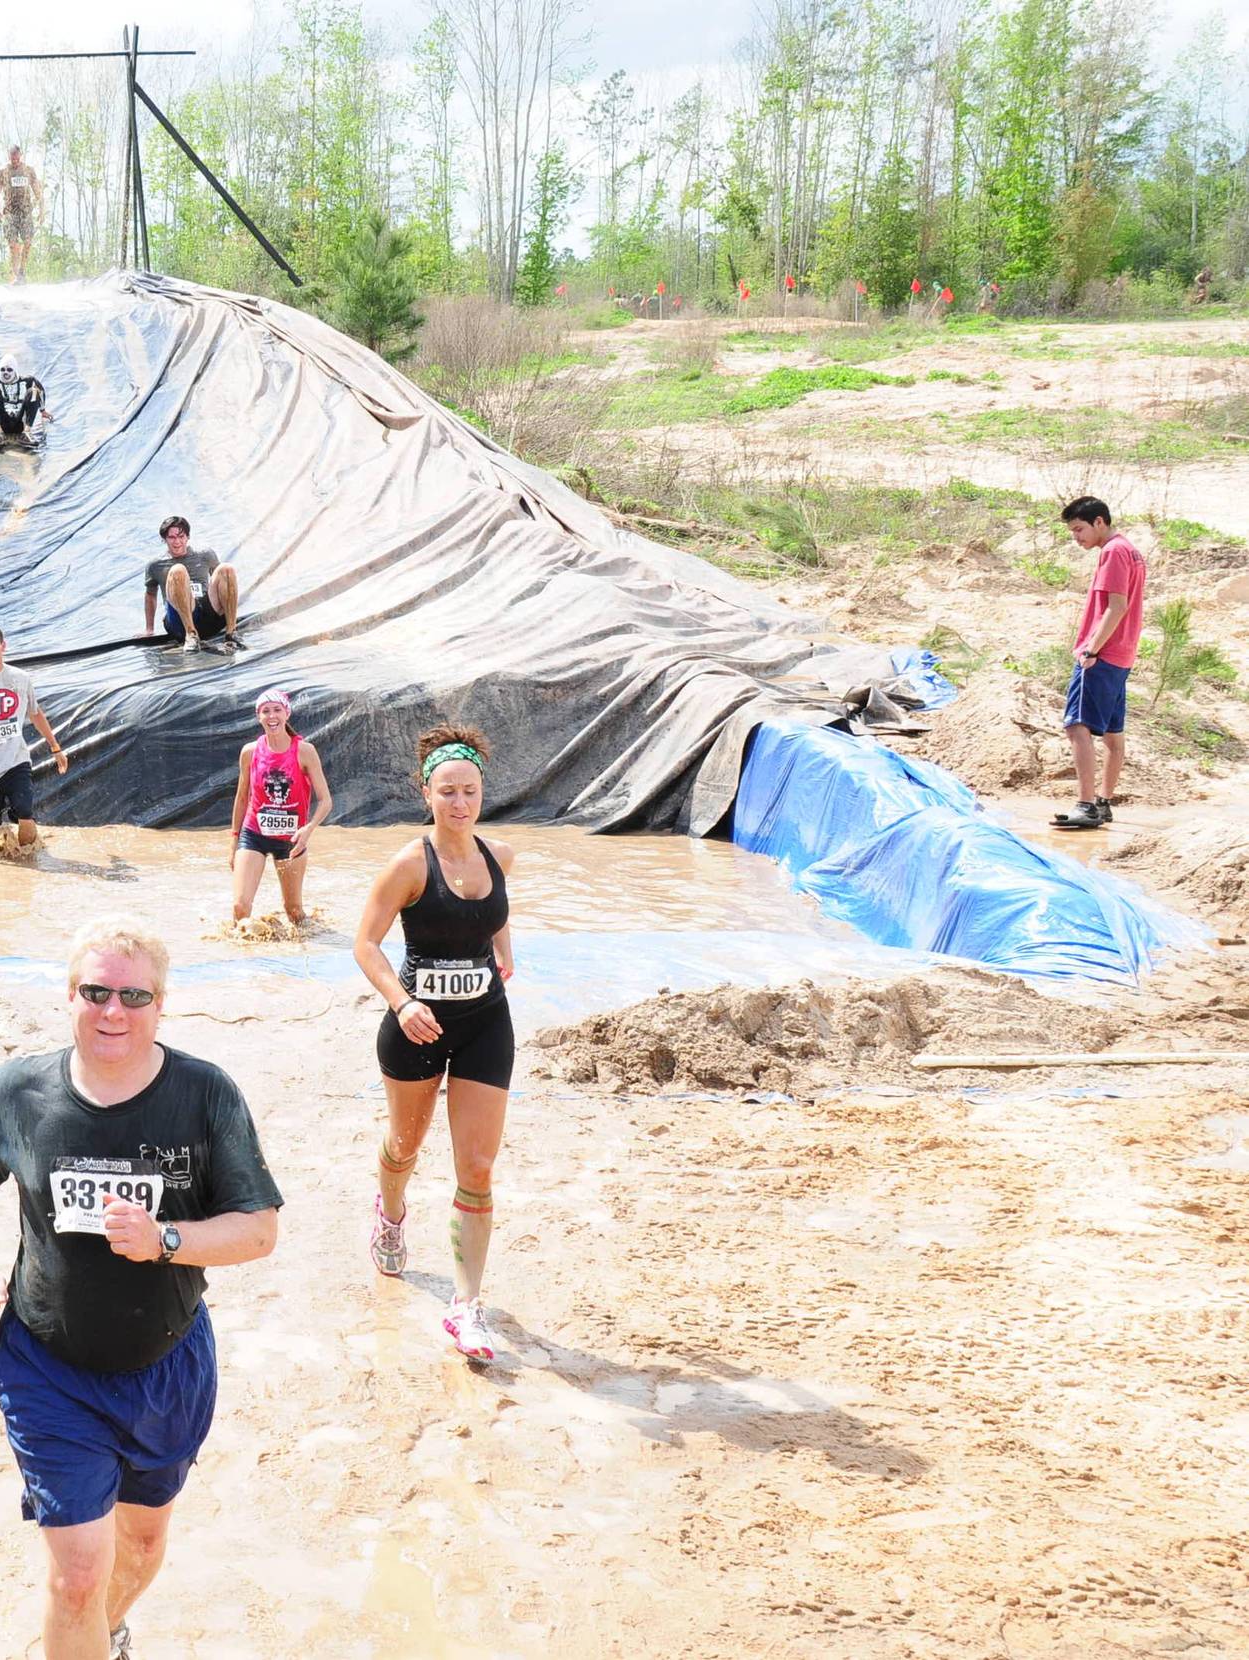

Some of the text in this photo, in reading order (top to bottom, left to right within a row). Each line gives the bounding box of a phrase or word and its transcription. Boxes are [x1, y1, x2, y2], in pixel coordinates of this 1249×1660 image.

[260, 815, 295, 829] 29556
[423, 973, 484, 995] 41007
[60, 1177, 154, 1213] 33189
